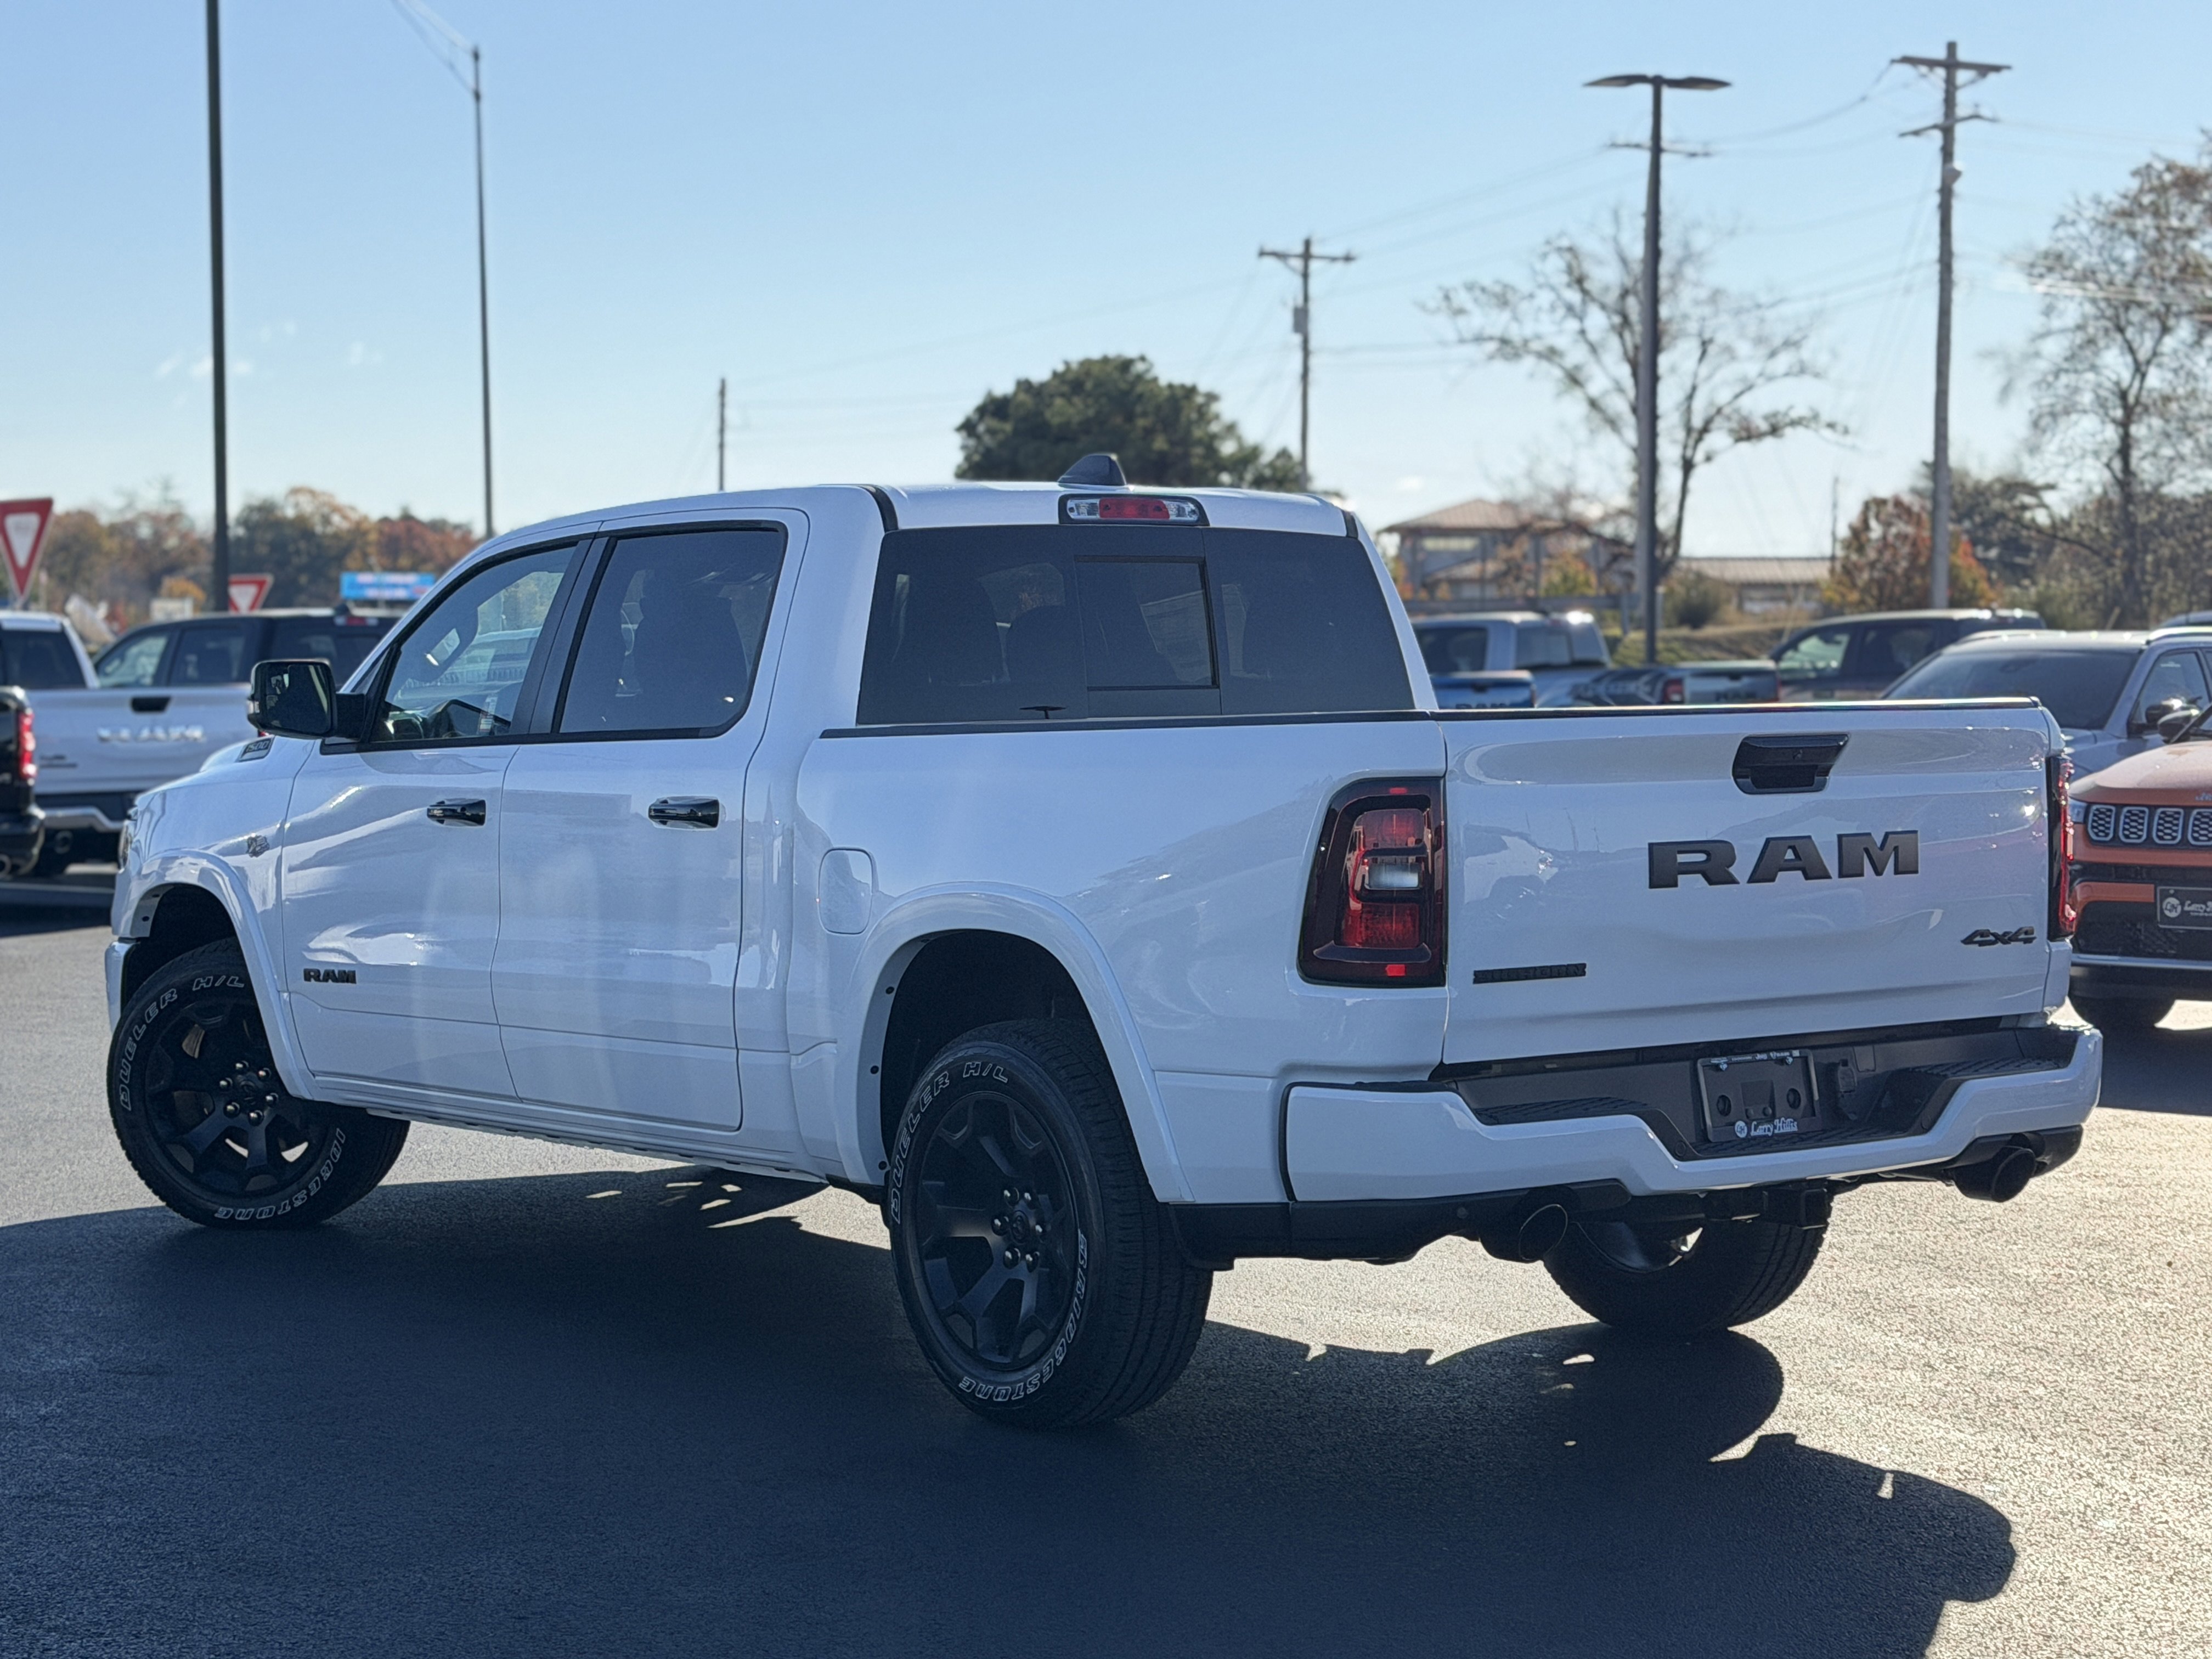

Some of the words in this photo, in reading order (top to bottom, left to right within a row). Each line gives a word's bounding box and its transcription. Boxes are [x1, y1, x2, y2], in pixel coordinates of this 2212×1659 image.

[245, 740, 269, 752] 1500
[1648, 830, 1919, 889] RAM
[1960, 926, 2037, 947] 4x4
[303, 968, 357, 984] RAM
[120, 989, 178, 1111] DUELER
[193, 975, 245, 991] H/L
[891, 1071, 950, 1224] DUELER
[963, 1062, 1008, 1083] H/L
[1750, 1121, 1773, 1136] Larry
[215, 1127, 346, 1221] IDGESTONE
[958, 1229, 1087, 1401] BRIDGESTONE
